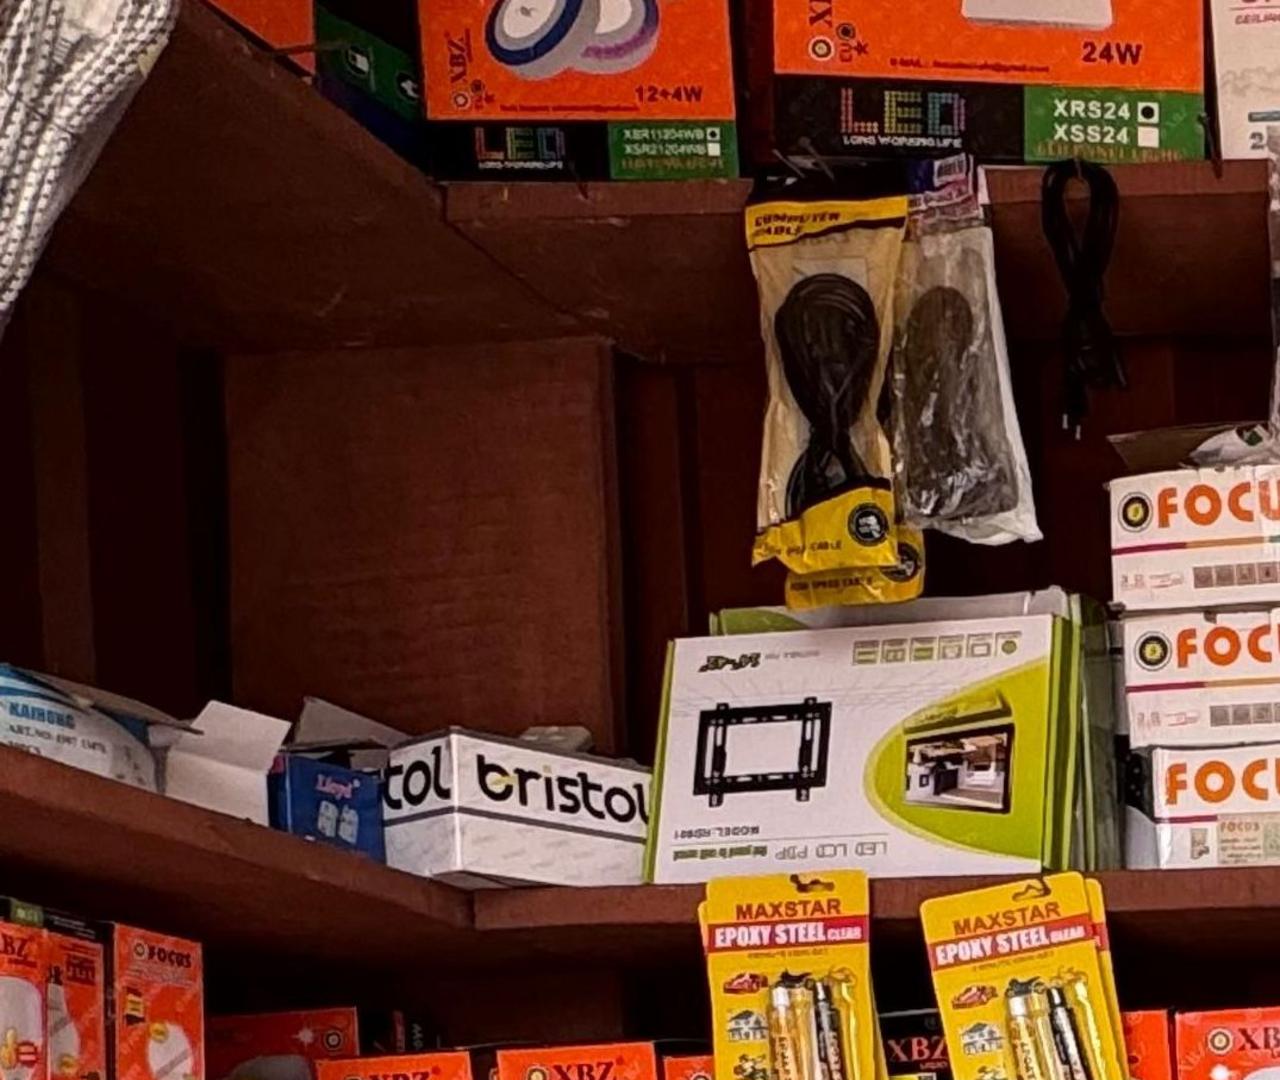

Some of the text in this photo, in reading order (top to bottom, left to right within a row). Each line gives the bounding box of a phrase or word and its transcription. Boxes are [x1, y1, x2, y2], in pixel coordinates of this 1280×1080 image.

[1081, 42, 1143, 65] 24W
[635, 86, 703, 104] 12+4W
[1053, 98, 1131, 120] XRS24
[840, 87, 967, 136] LED
[474, 126, 566, 161] LED
[1053, 122, 1129, 145] XSS24
[477, 753, 652, 824] bristol
[735, 898, 842, 920] MAXSTAR
[952, 900, 1062, 936] MAXSTAR
[0, 932, 30, 960] BZ
[714, 924, 772, 949] EPOXY
[774, 921, 827, 945] STEEL
[934, 938, 997, 967] EPOXY
[998, 929, 1050, 956] STEEL
[887, 1035, 950, 1061] XBZ
